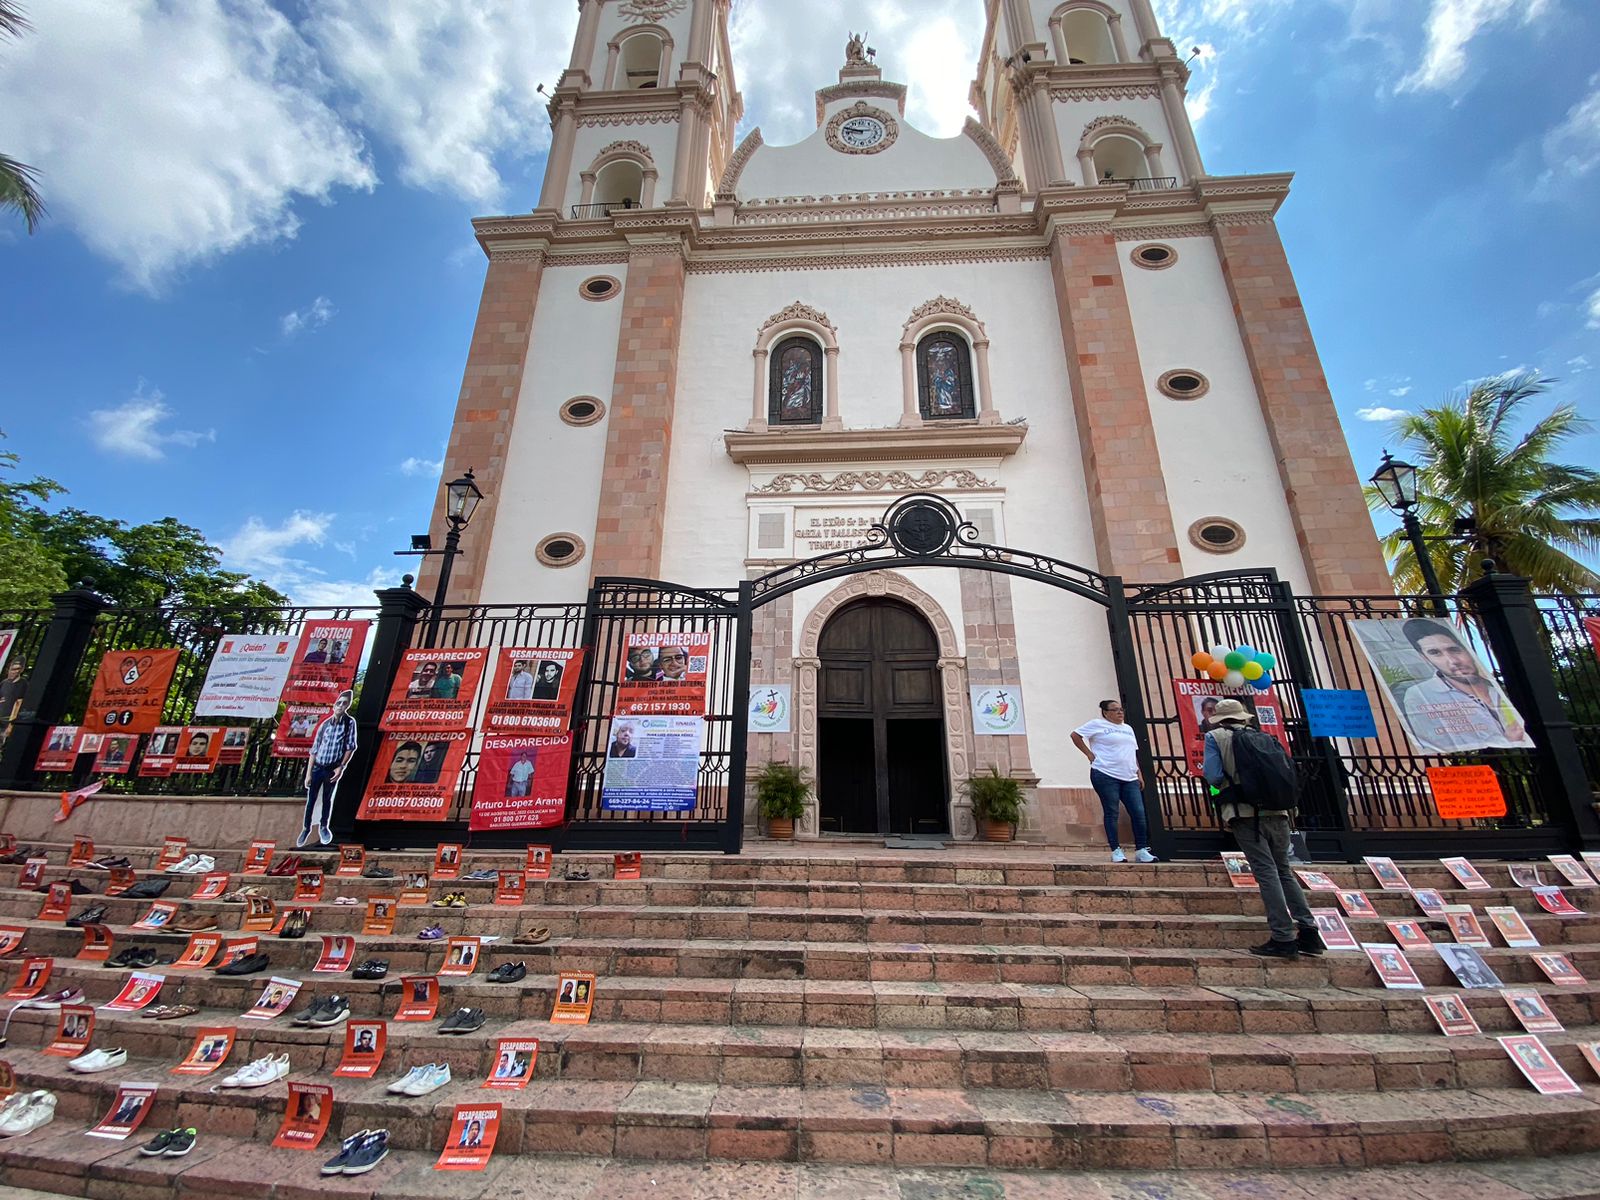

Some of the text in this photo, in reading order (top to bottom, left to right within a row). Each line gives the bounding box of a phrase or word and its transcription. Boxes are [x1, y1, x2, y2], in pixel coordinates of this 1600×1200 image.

[810, 518, 821, 526] EL
[824, 529, 830, 538] Y
[808, 540, 841, 550] TEMPLO
[310, 627, 354, 640] JUSTICIA
[628, 634, 709, 646] DESAPARECIDO
[239, 643, 266, 652] ¿Quién?
[406, 651, 482, 661] DESAPARECIDO
[509, 650, 574, 660] DESAPARECIDO
[105, 686, 149, 696] SABUESOS
[288, 705, 330, 714] DESAPARECIDO
[630, 702, 690, 711] 667 157 1930
[388, 710, 464, 720] 018006703600
[491, 715, 561, 728] 01 800 6703600
[388, 732, 466, 741] DESAPARECIDO
[485, 734, 569, 749] DESAPARECIDO
[368, 797, 444, 808] 018006703600
[474, 797, 563, 809] Arturo Lopez Arana
[500, 1042, 536, 1051] DESAPARECIDO
[457, 1110, 498, 1120] DESAPARECIDO
